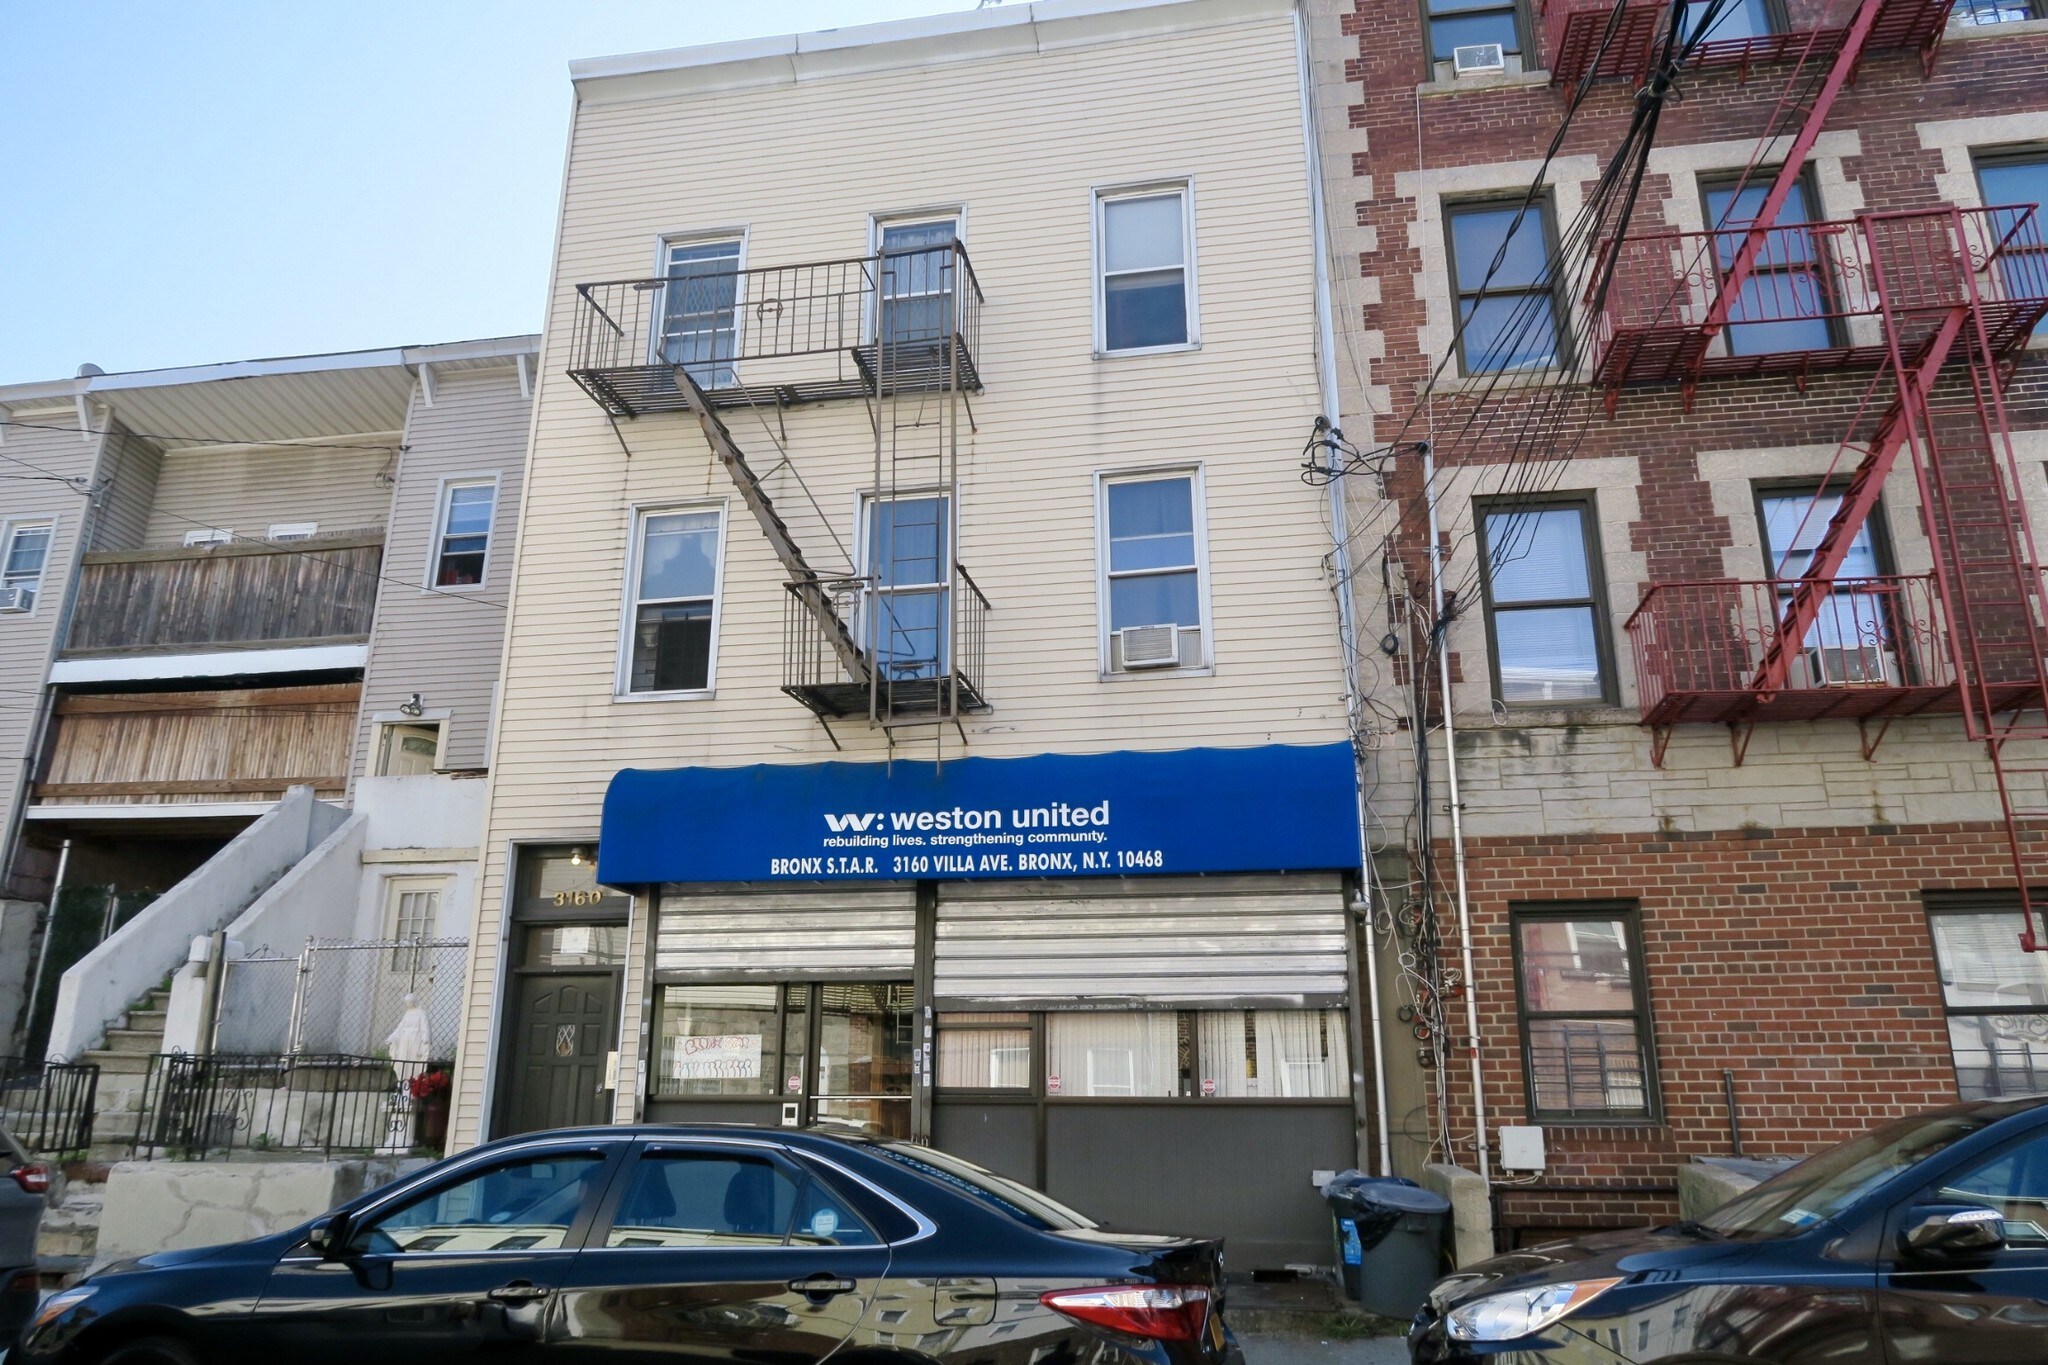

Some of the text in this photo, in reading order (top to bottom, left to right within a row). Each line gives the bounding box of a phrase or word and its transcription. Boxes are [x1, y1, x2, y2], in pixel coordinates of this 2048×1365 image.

[890, 806, 1001, 831] weston
[1012, 800, 1110, 830] united
[823, 830, 1108, 849] rebuilding lives. strengthening community.
[770, 850, 1163, 875] BRONX S.T.A.R. 3160 VILLA AVE. BRONX, N.Y. 10468
[553, 890, 604, 907] 3160
